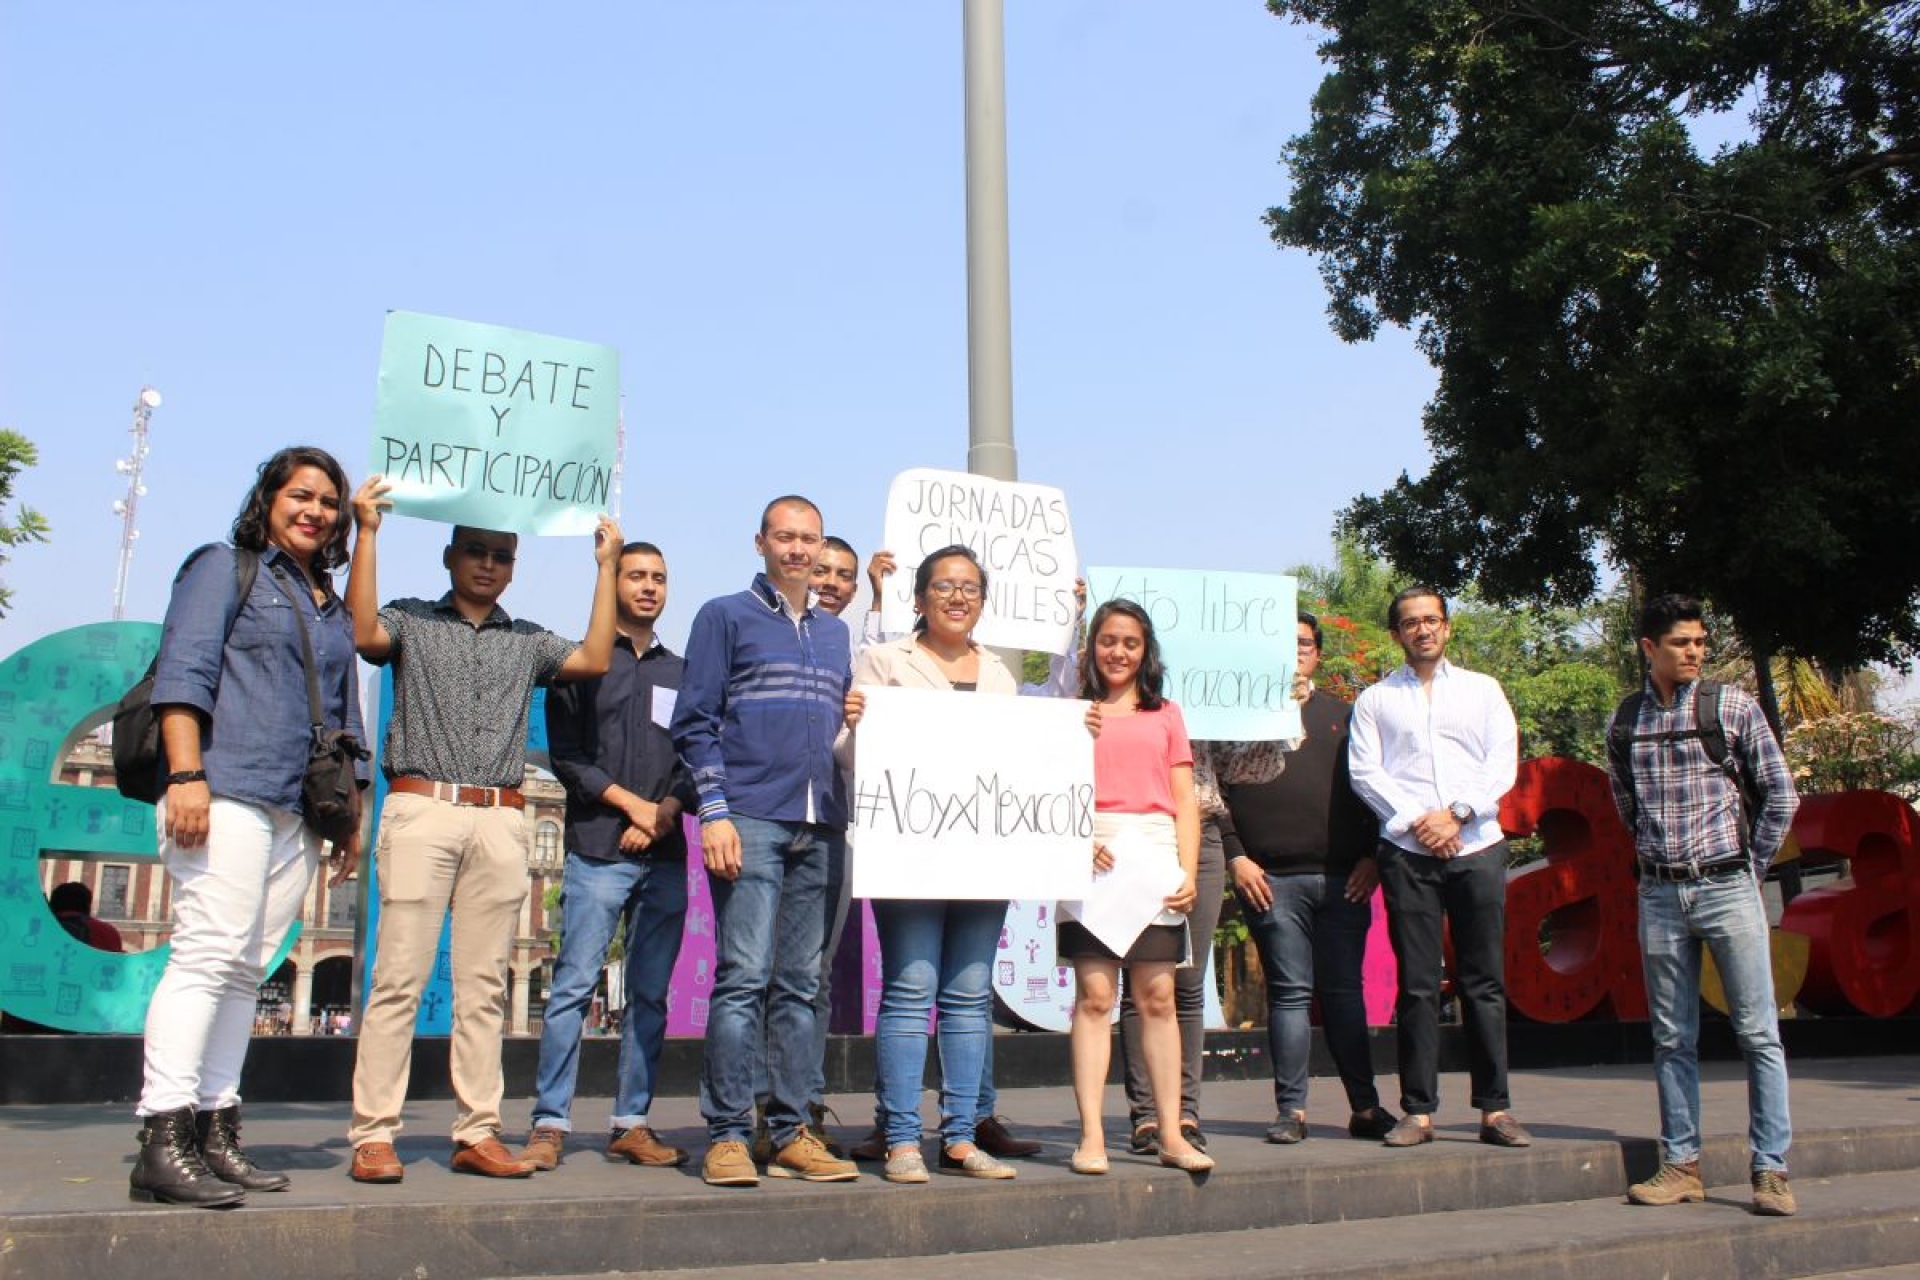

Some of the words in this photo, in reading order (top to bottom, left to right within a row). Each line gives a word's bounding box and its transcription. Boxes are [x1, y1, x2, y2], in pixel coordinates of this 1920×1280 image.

[423, 343, 595, 410] DEBATE
[490, 404, 511, 437] Y
[381, 436, 612, 506] PARTICIPACIÓN
[907, 479, 1068, 535] JORNADAS
[897, 565, 1071, 627] JNILES
[1200, 576, 1280, 636] libre
